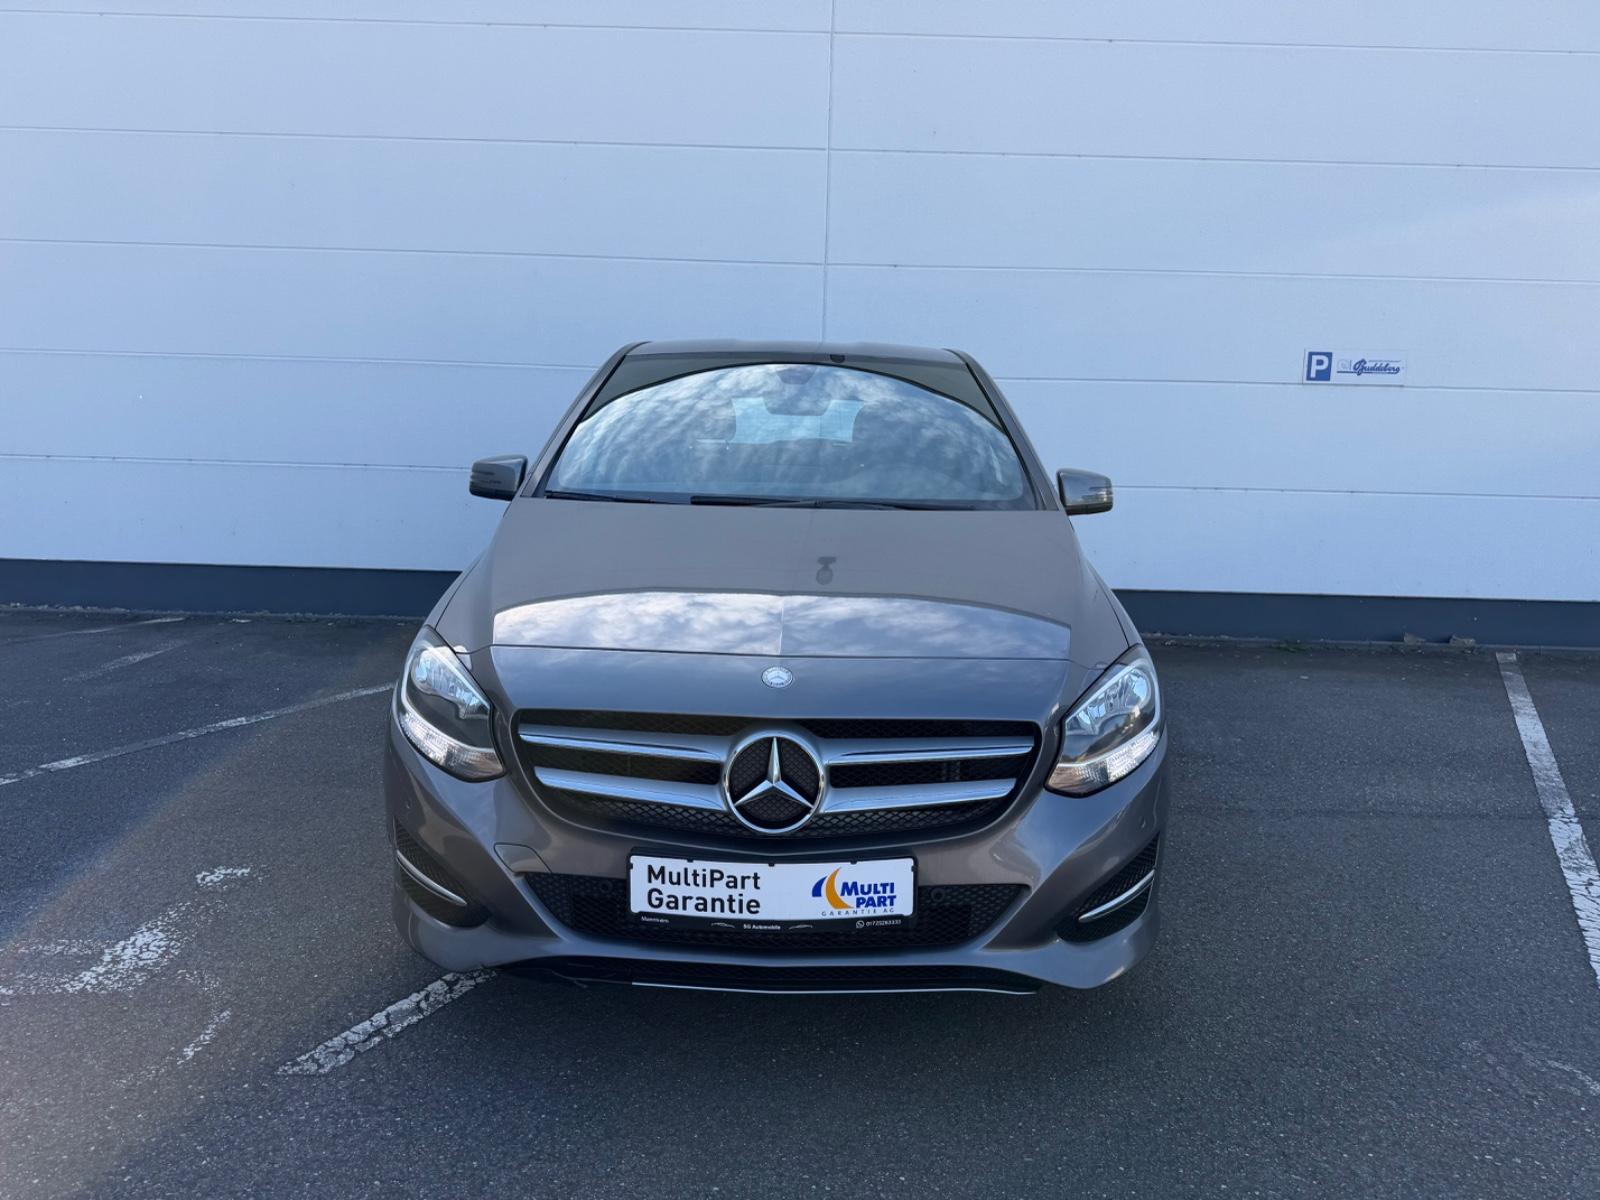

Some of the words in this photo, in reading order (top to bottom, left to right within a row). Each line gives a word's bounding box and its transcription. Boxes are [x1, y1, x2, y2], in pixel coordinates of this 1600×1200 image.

[1310, 354, 1329, 379] P
[647, 864, 760, 890] MultiPart
[647, 887, 760, 914] Garantie
[821, 908, 877, 917] GARANTIE
[856, 895, 897, 908] PART
